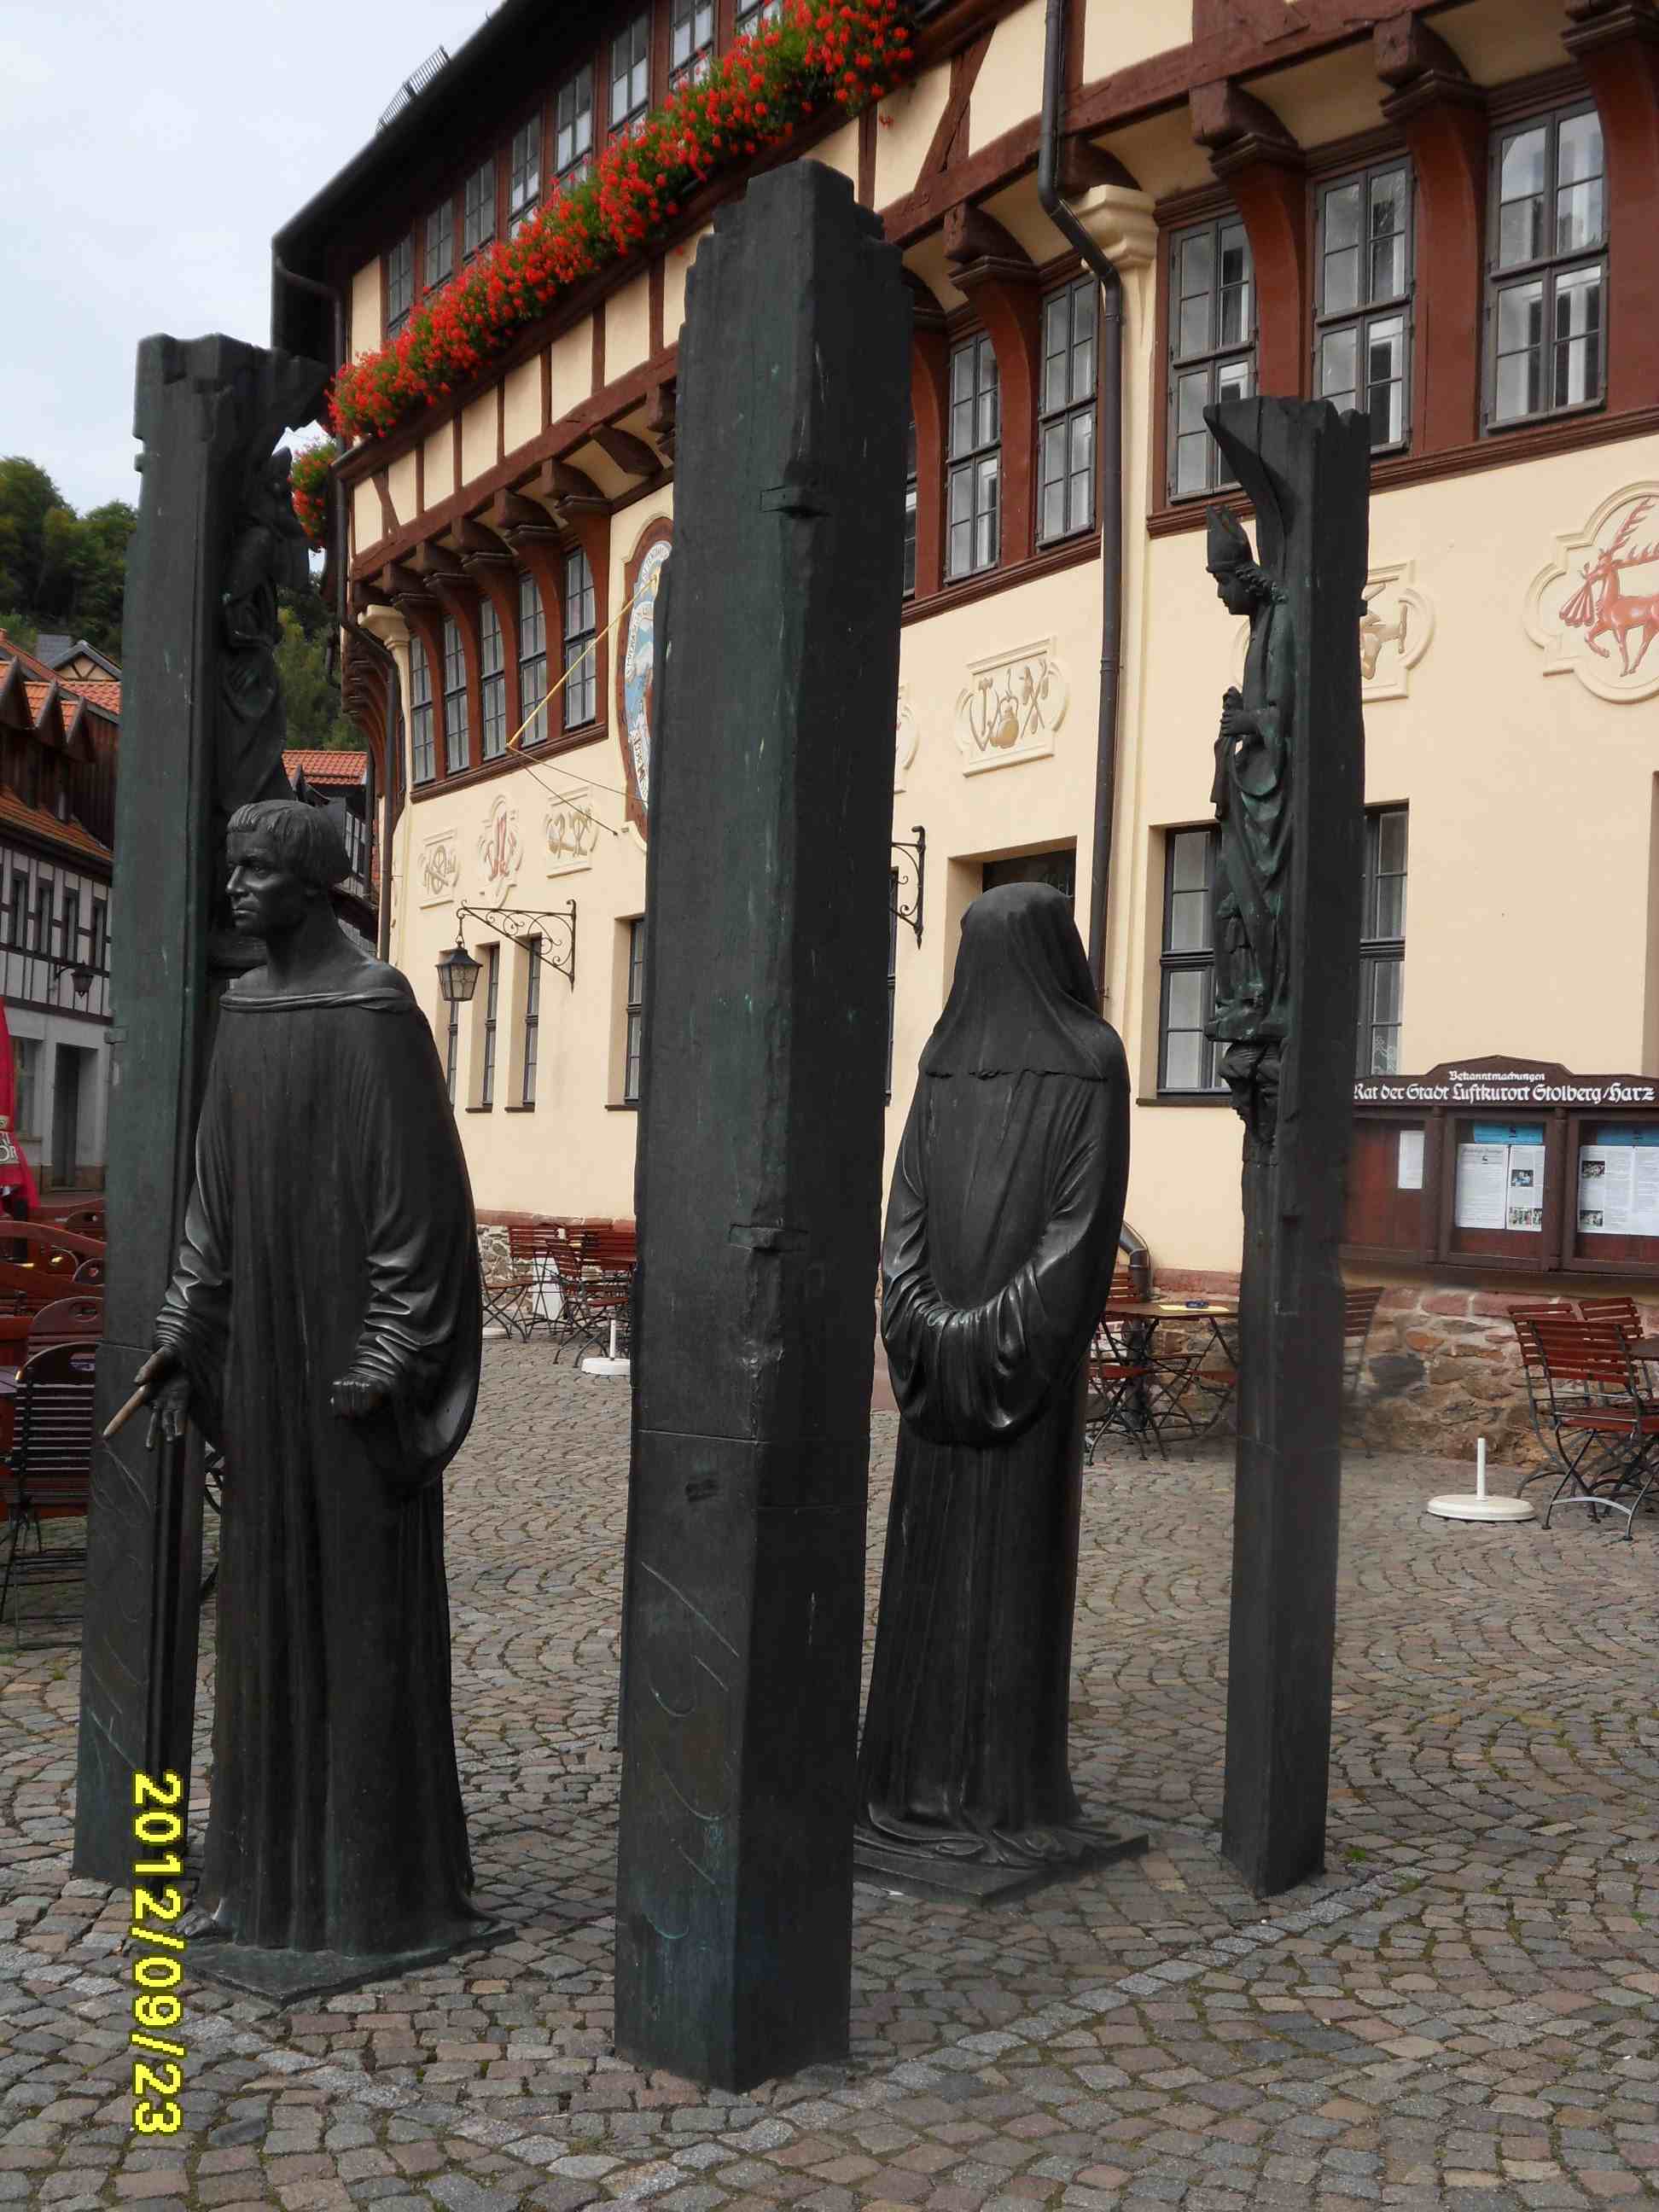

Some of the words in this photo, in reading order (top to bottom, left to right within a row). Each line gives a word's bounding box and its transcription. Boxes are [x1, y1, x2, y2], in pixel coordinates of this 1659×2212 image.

[1449, 1070, 1545, 1083] Bekanntmachungen
[1353, 1083, 1378, 1100] Rat
[1380, 1084, 1406, 1100] der
[1406, 1083, 1450, 1100] Stadt
[1452, 1083, 1530, 1104] Luftkurort
[1533, 1082, 1656, 1104] Stolberg/Harz
